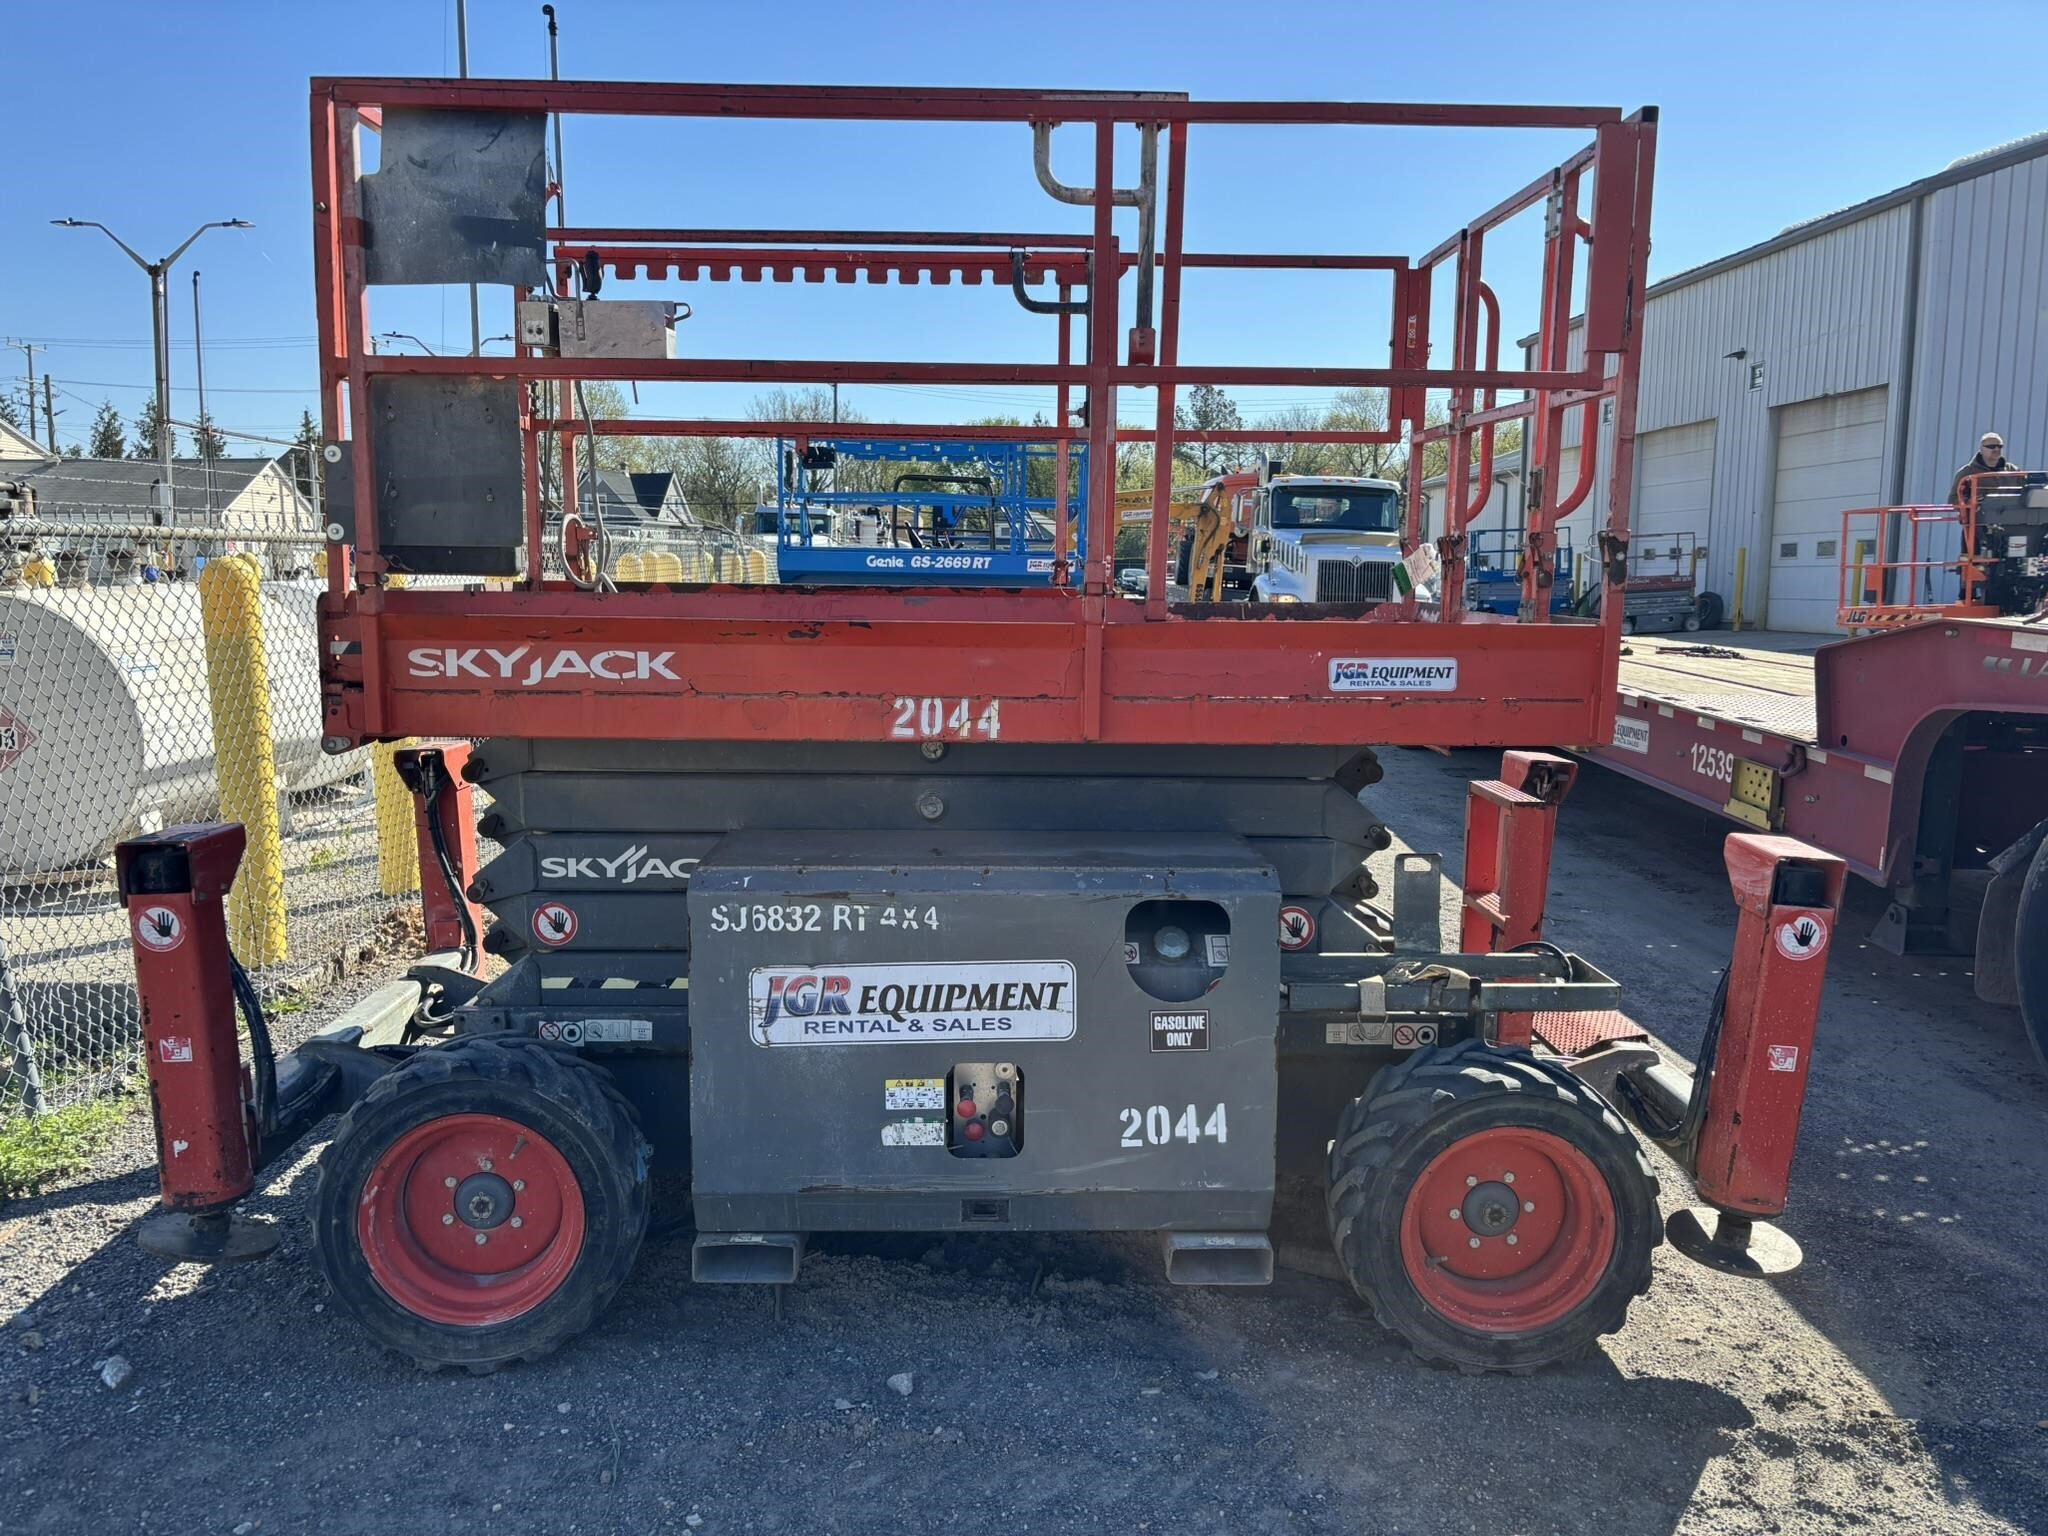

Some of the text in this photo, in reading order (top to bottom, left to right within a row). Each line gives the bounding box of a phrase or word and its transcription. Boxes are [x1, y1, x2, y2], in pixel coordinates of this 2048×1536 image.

[866, 555, 992, 569] Genie GS-2669 RT
[1847, 610, 1867, 623] JLG
[407, 642, 681, 686] SKYJACK
[1332, 662, 1455, 684] JGR EQUIPMENT
[892, 697, 1001, 739] 2044
[1617, 724, 1648, 742] EQUIPMENT
[1690, 742, 1734, 783] 12539
[541, 844, 699, 884] SKYJAC
[710, 904, 822, 932] SJ6832
[833, 904, 871, 932] RT
[758, 975, 1069, 1028] JGR EQUIPMENT
[804, 1017, 1012, 1035] RENTAL & SALES
[1153, 1015, 1205, 1031] GASOLINE
[1166, 1032, 1193, 1047] ONLY
[1119, 1102, 1227, 1148] 2044
